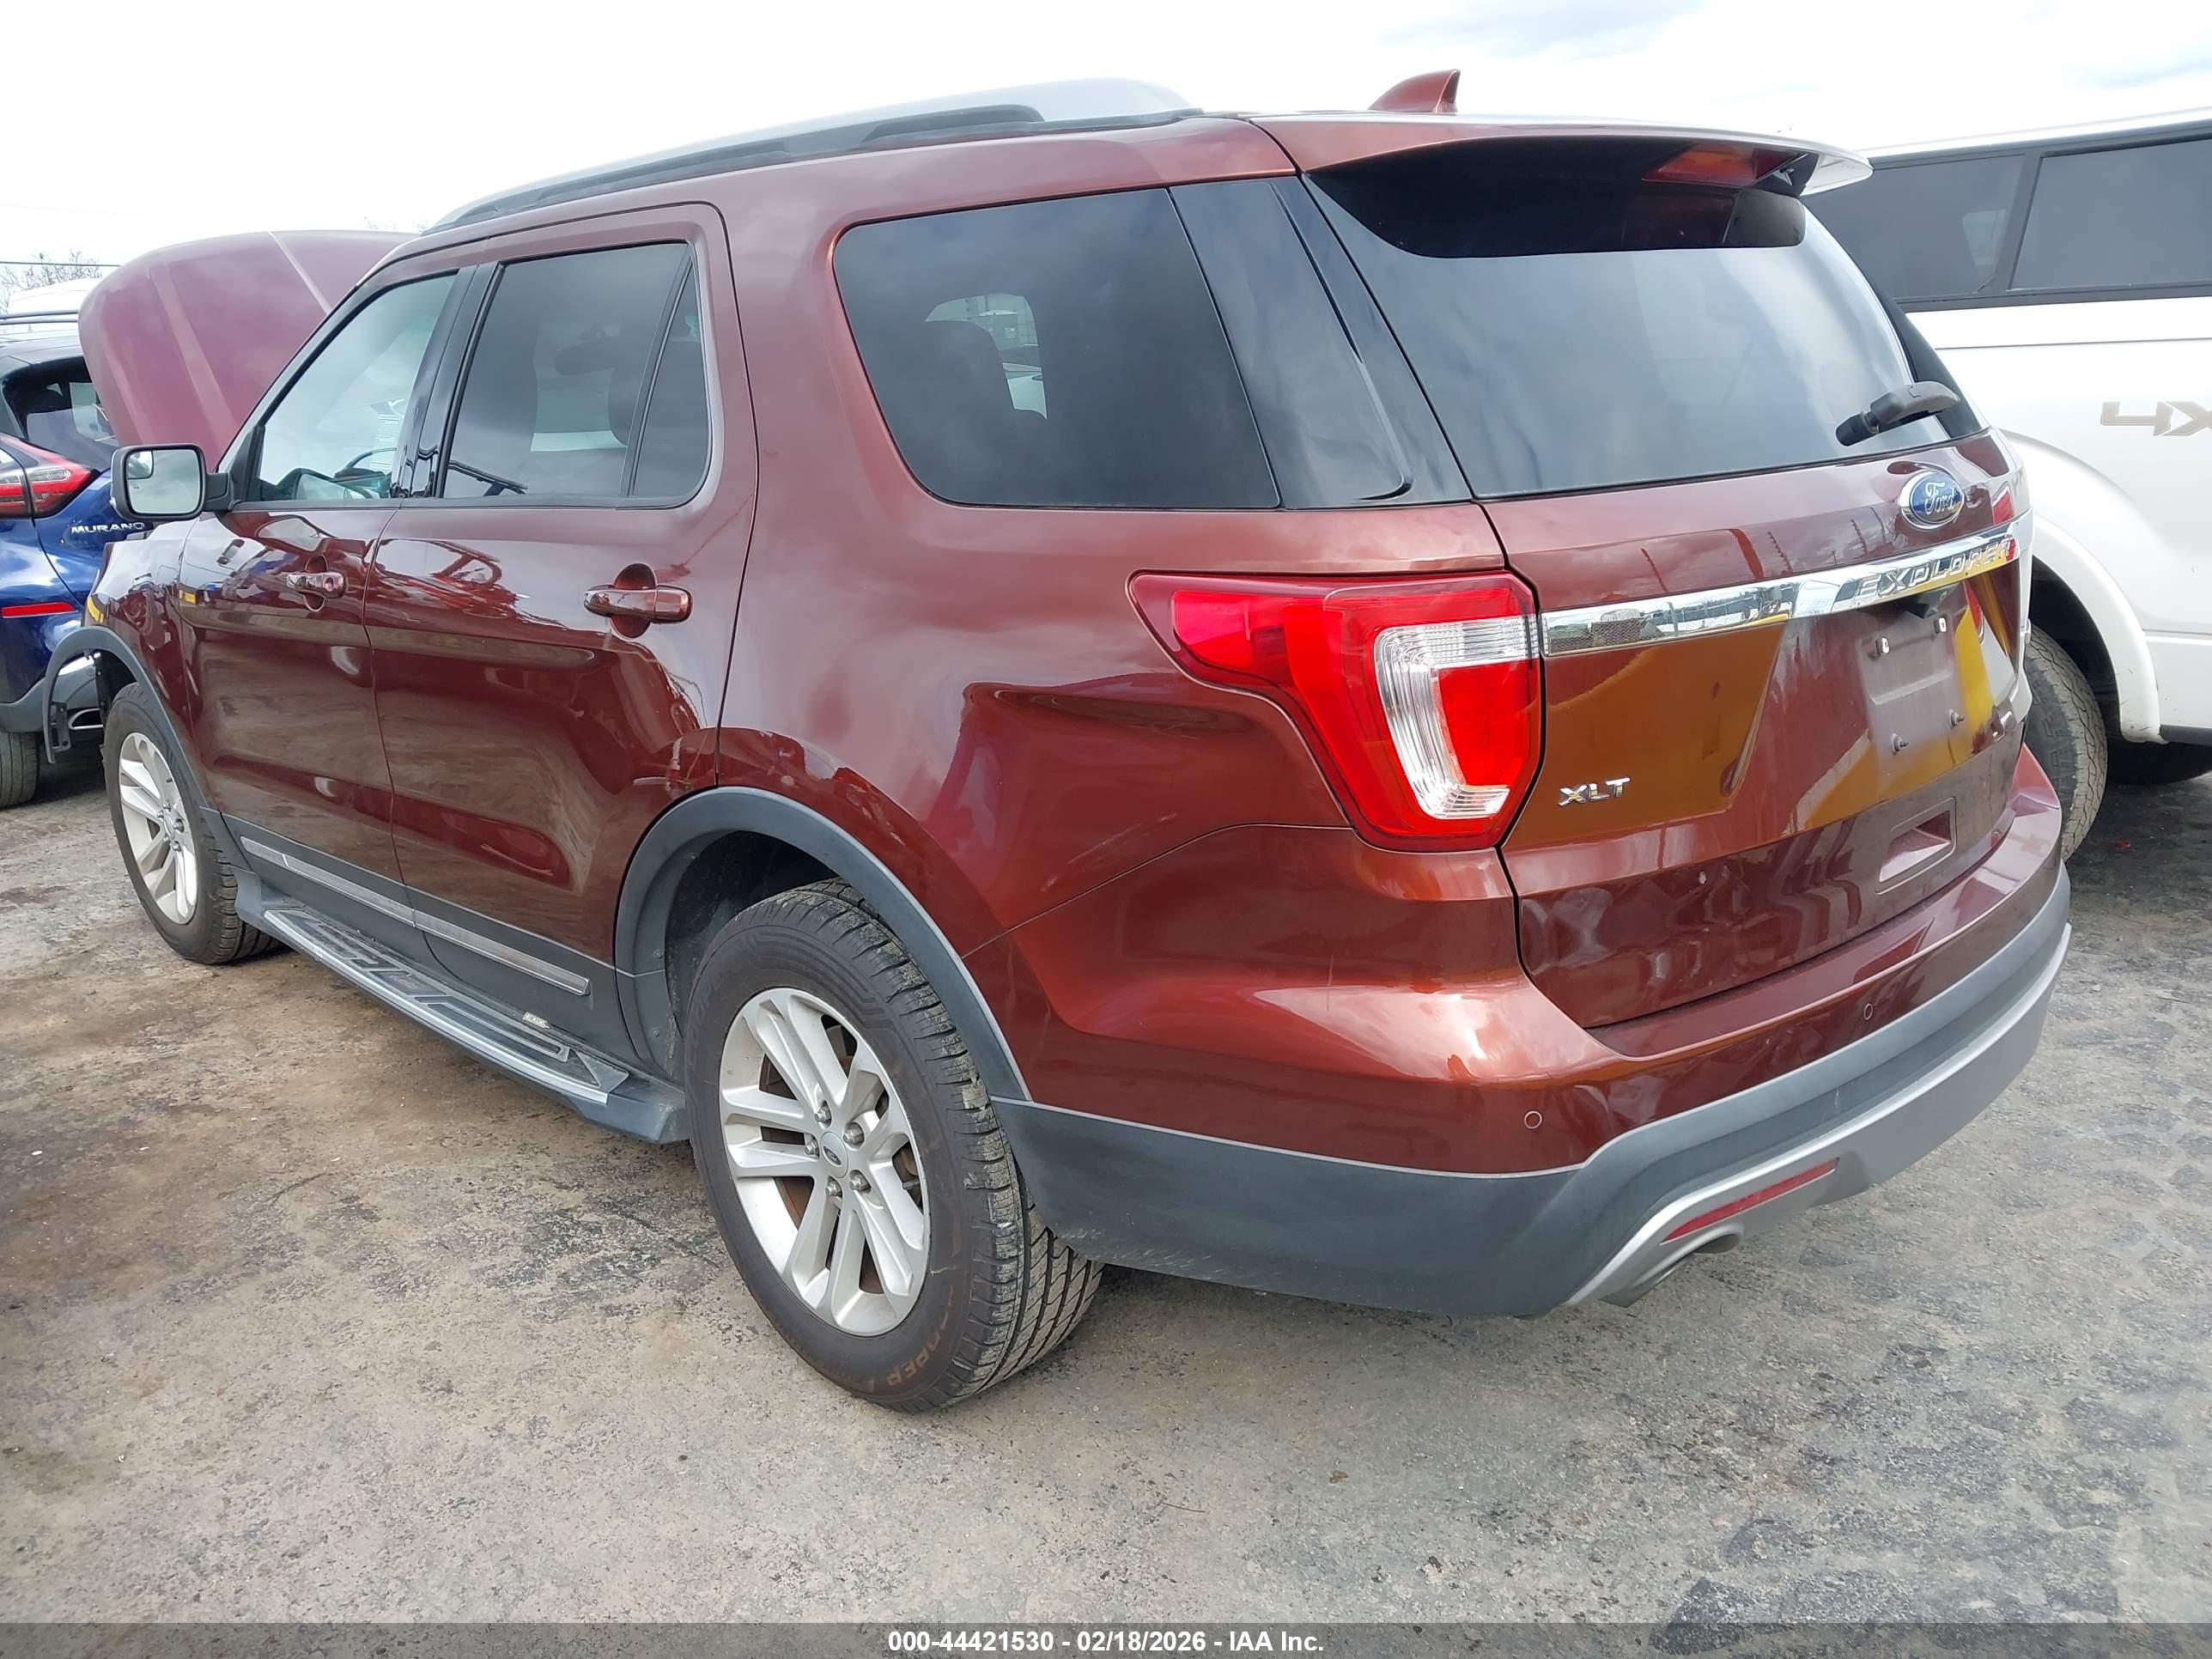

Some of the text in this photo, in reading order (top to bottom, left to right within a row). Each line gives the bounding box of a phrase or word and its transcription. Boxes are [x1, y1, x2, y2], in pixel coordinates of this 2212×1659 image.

[71, 521, 145, 534] MURANO
[1855, 536, 2012, 597] EXPLORER
[1558, 776, 1631, 807] XLT
